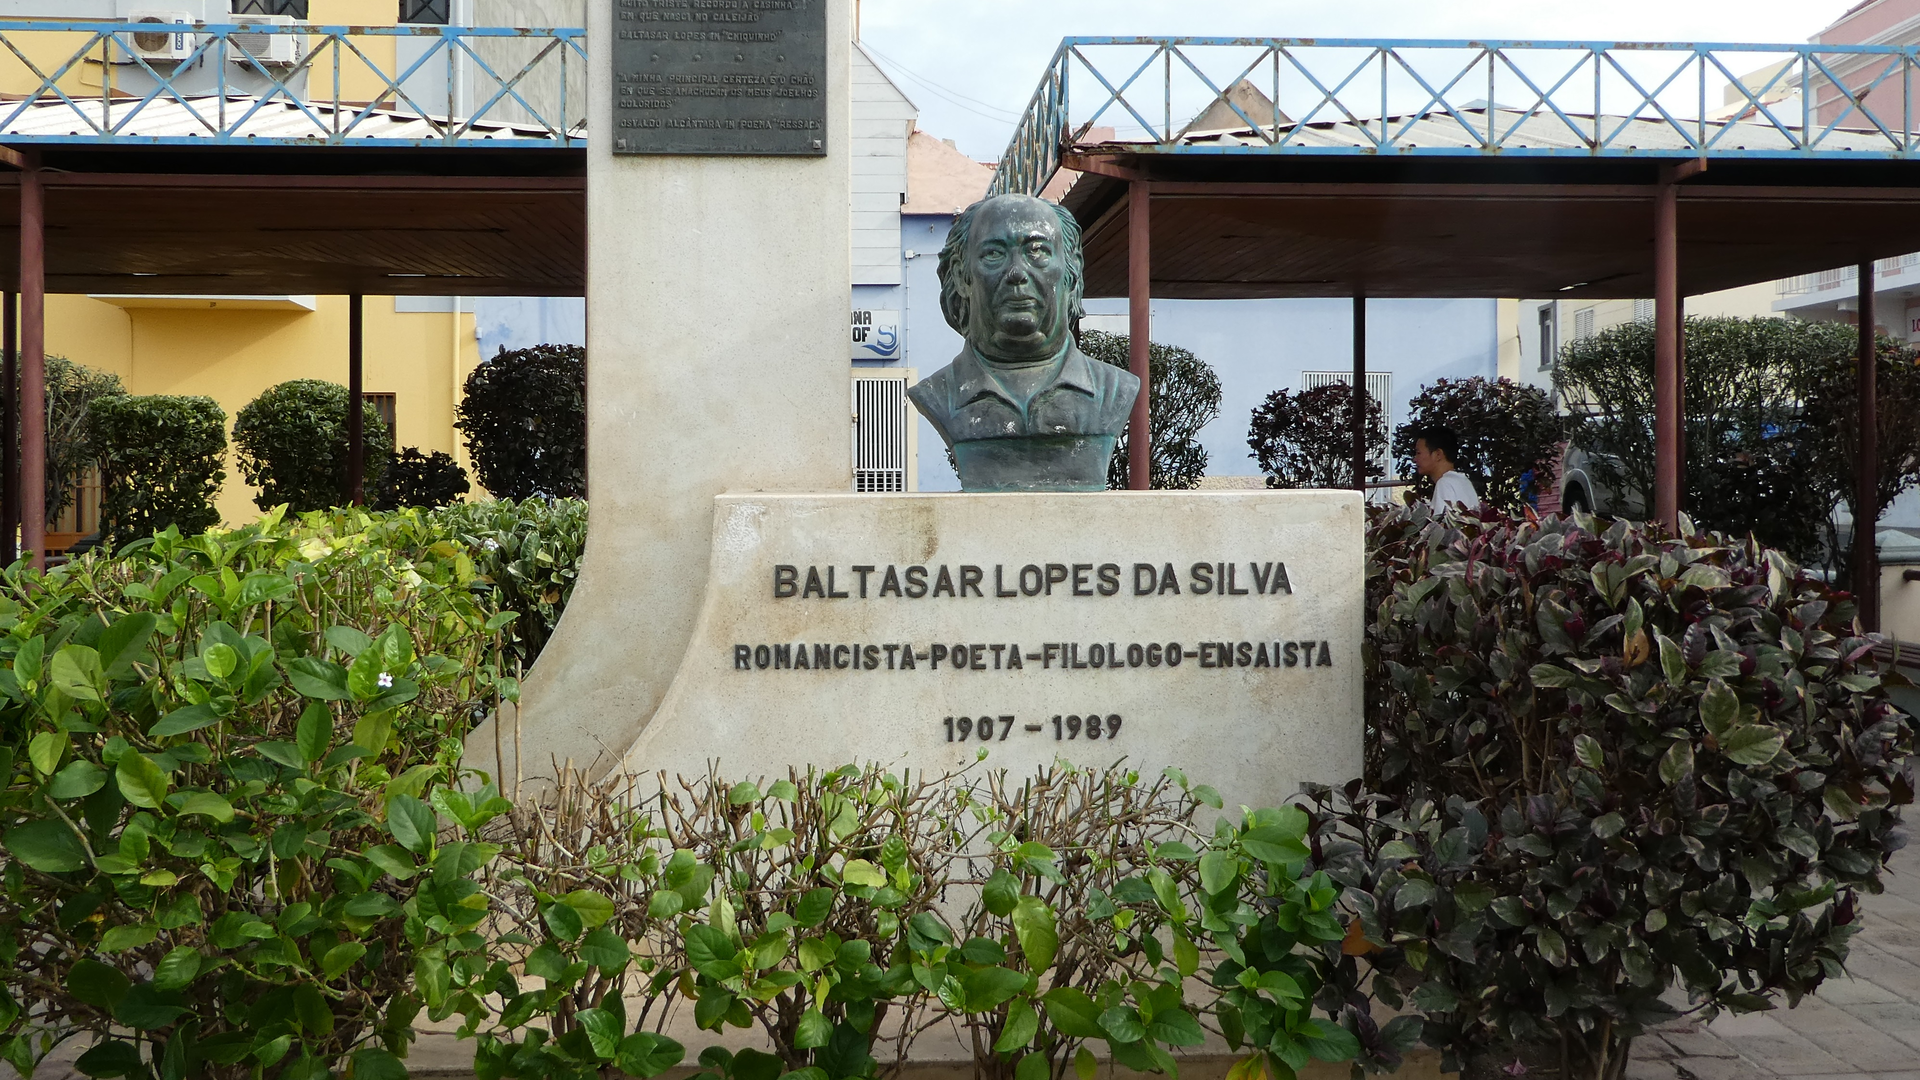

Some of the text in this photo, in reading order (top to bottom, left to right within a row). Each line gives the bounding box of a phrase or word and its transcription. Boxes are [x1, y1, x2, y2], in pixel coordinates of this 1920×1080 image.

[694, 0, 738, 8] RECORDO
[742, 0, 749, 9] A
[640, 11, 659, 22] QUE
[620, 30, 669, 40] BALTASAR
[674, 31, 706, 40] LOPES
[710, 32, 720, 40] IN
[632, 73, 662, 82] MINHA
[669, 74, 719, 84] PRINCIPAL
[723, 75, 766, 84] CERTEZA
[790, 73, 815, 85] CHÃO
[638, 86, 656, 97] QUE
[660, 87, 672, 96] SE
[731, 88, 742, 96] OS
[747, 88, 772, 97] MEUS
[776, 88, 818, 98] JOELHOS
[620, 119, 661, 128] OSVALDO
[725, 120, 736, 129] IN
[740, 120, 772, 129] POEMA
[774, 561, 1293, 599] BALTASAR LOPES DA SILVA
[943, 715, 1015, 743] 1907
[1051, 713, 1123, 741] 1989
